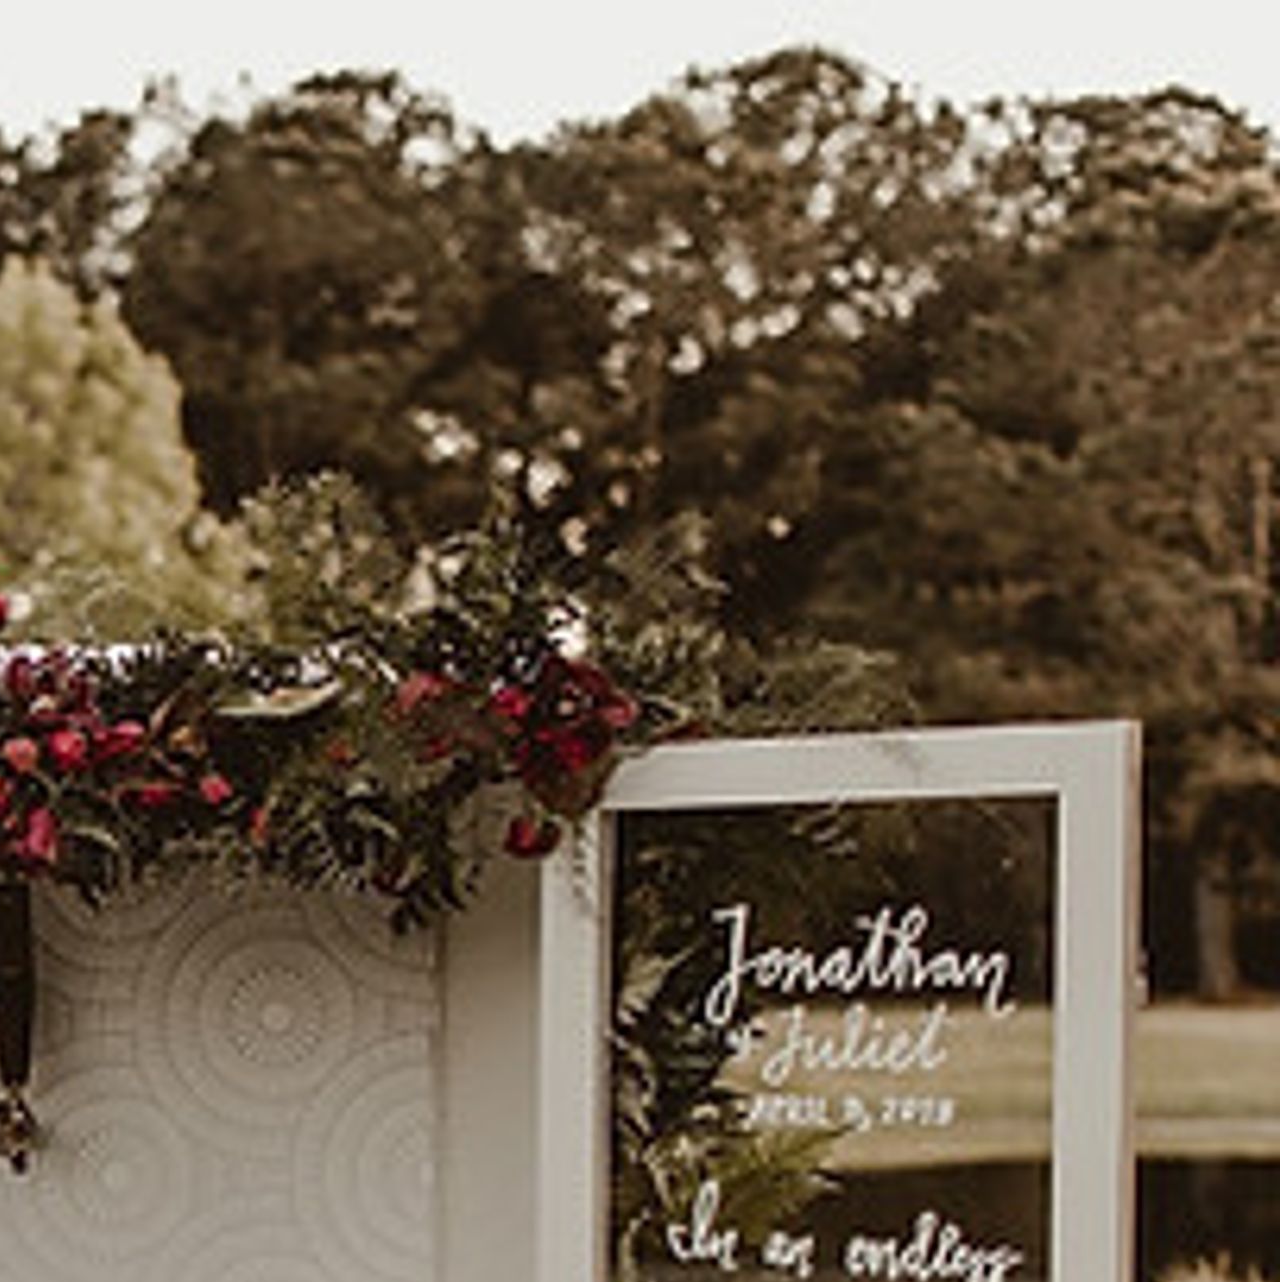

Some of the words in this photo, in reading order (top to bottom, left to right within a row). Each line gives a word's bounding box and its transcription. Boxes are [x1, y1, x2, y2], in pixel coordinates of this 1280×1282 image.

[705, 904, 1016, 1025] Jonathan
[762, 1002, 948, 1086] Juliet
[667, 1180, 739, 1272] In
[763, 1231, 815, 1279] an
